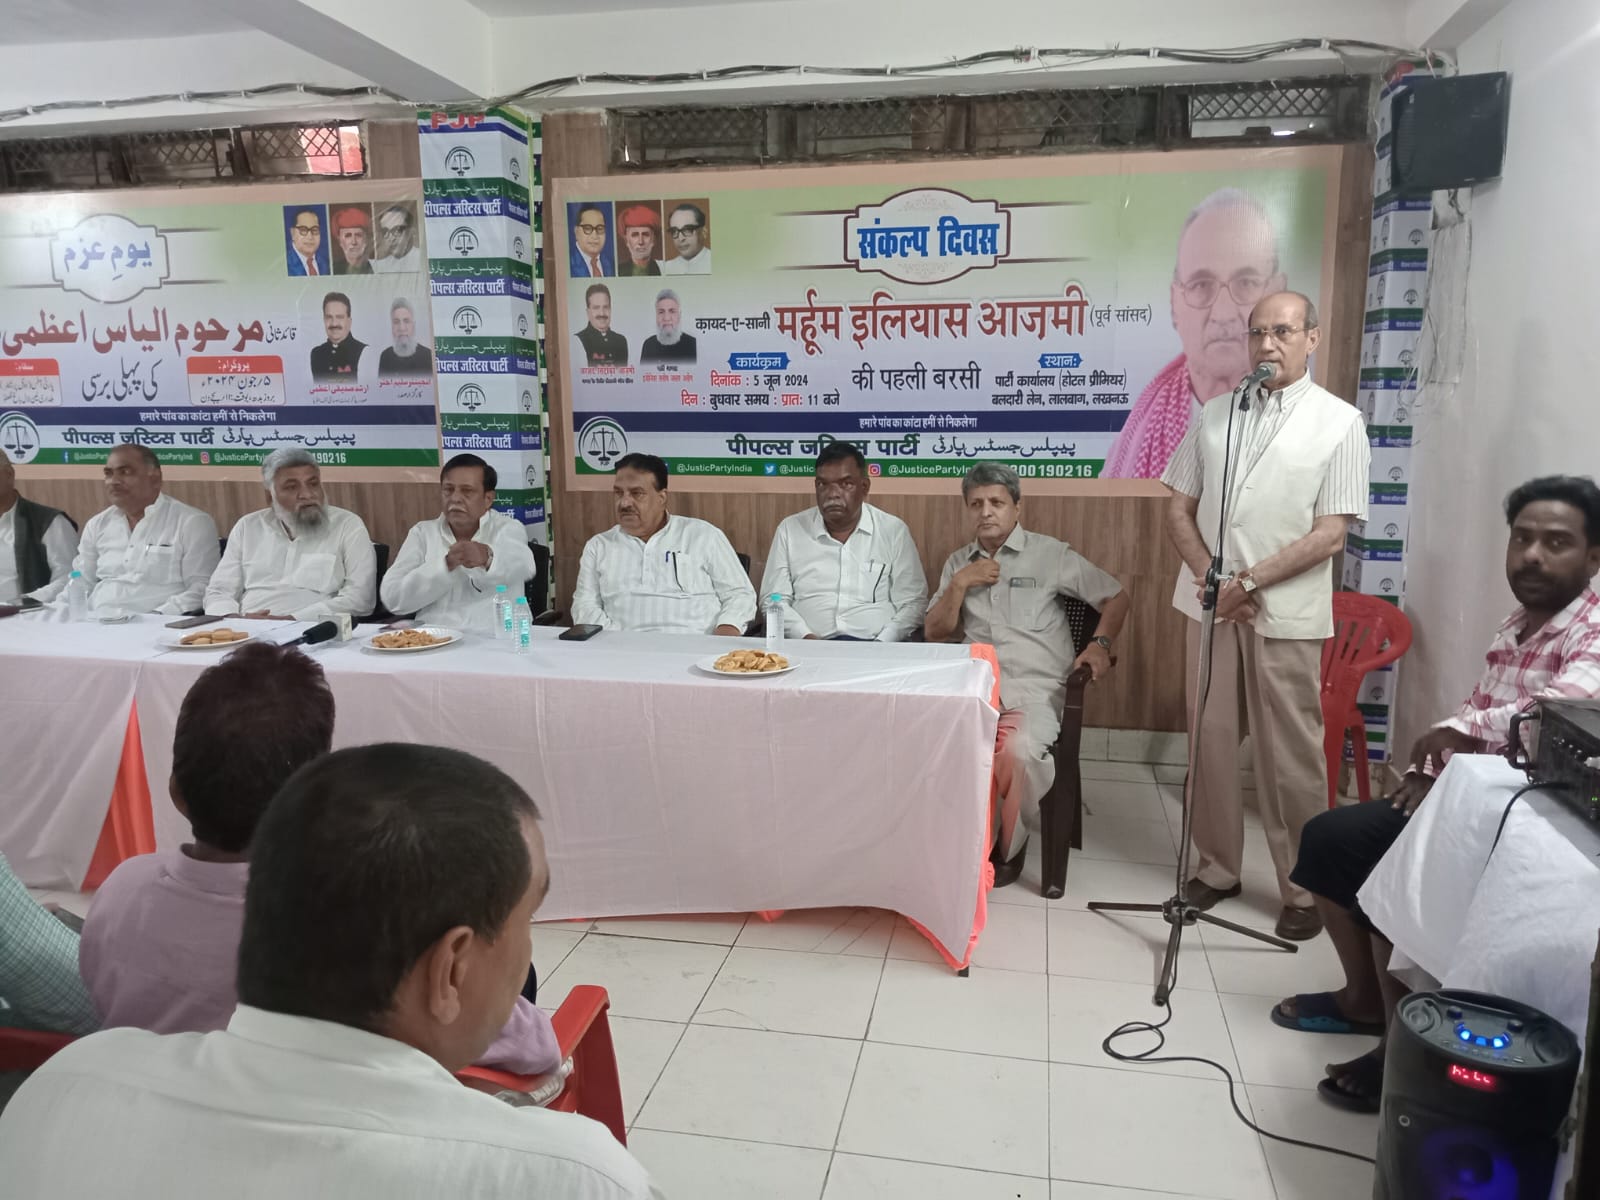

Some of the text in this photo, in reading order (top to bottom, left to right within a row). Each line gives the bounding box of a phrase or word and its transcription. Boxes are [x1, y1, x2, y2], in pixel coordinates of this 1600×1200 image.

[431, 112, 485, 129] PJP
[857, 216, 1000, 258] संकल्प दिवस
[64, 239, 105, 272] عزم
[92, 306, 169, 354] الیاس
[849, 291, 972, 350] इलियास
[1090, 304, 1112, 328] (पूर्व
[1114, 304, 1152, 327] सांसद)
[2, 308, 87, 357] اعظمی
[174, 318, 264, 357] مرحوم
[113, 356, 142, 401] پہلی
[143, 358, 163, 401] کی
[711, 370, 742, 387] दिनांक
[754, 375, 760, 386] 5
[764, 374, 781, 391] जून
[785, 375, 808, 386] 2024
[852, 361, 982, 391] की पहली बरसी
[995, 371, 1014, 387] पार्टी
[1017, 370, 1056, 387] कार्यालय
[1059, 369, 1086, 391] (होटल
[681, 389, 698, 406] दिन
[710, 393, 741, 410] बुधवार
[744, 393, 770, 406] समय
[808, 394, 818, 406] 11
[823, 389, 840, 406] बजे
[1027, 389, 1045, 406] लेन,
[1092, 393, 1130, 405] लखनऊ
[139, 409, 160, 422] हमारे
[177, 411, 189, 421] का
[239, 409, 276, 422] निकलेगा
[859, 415, 877, 429] हमारे
[878, 416, 891, 428] पांव
[892, 417, 902, 428] का
[903, 416, 921, 428] कांटा
[945, 414, 977, 428] निकलेगा
[62, 427, 215, 445] पीपल्स जस्टिस पार्टी
[726, 434, 794, 456] पीपल्स
[875, 433, 920, 456] पार्टी
[676, 464, 752, 474] @JusticPartyIndia
[779, 464, 815, 475] @Justic
[888, 464, 972, 476] @JusticePartyIn
